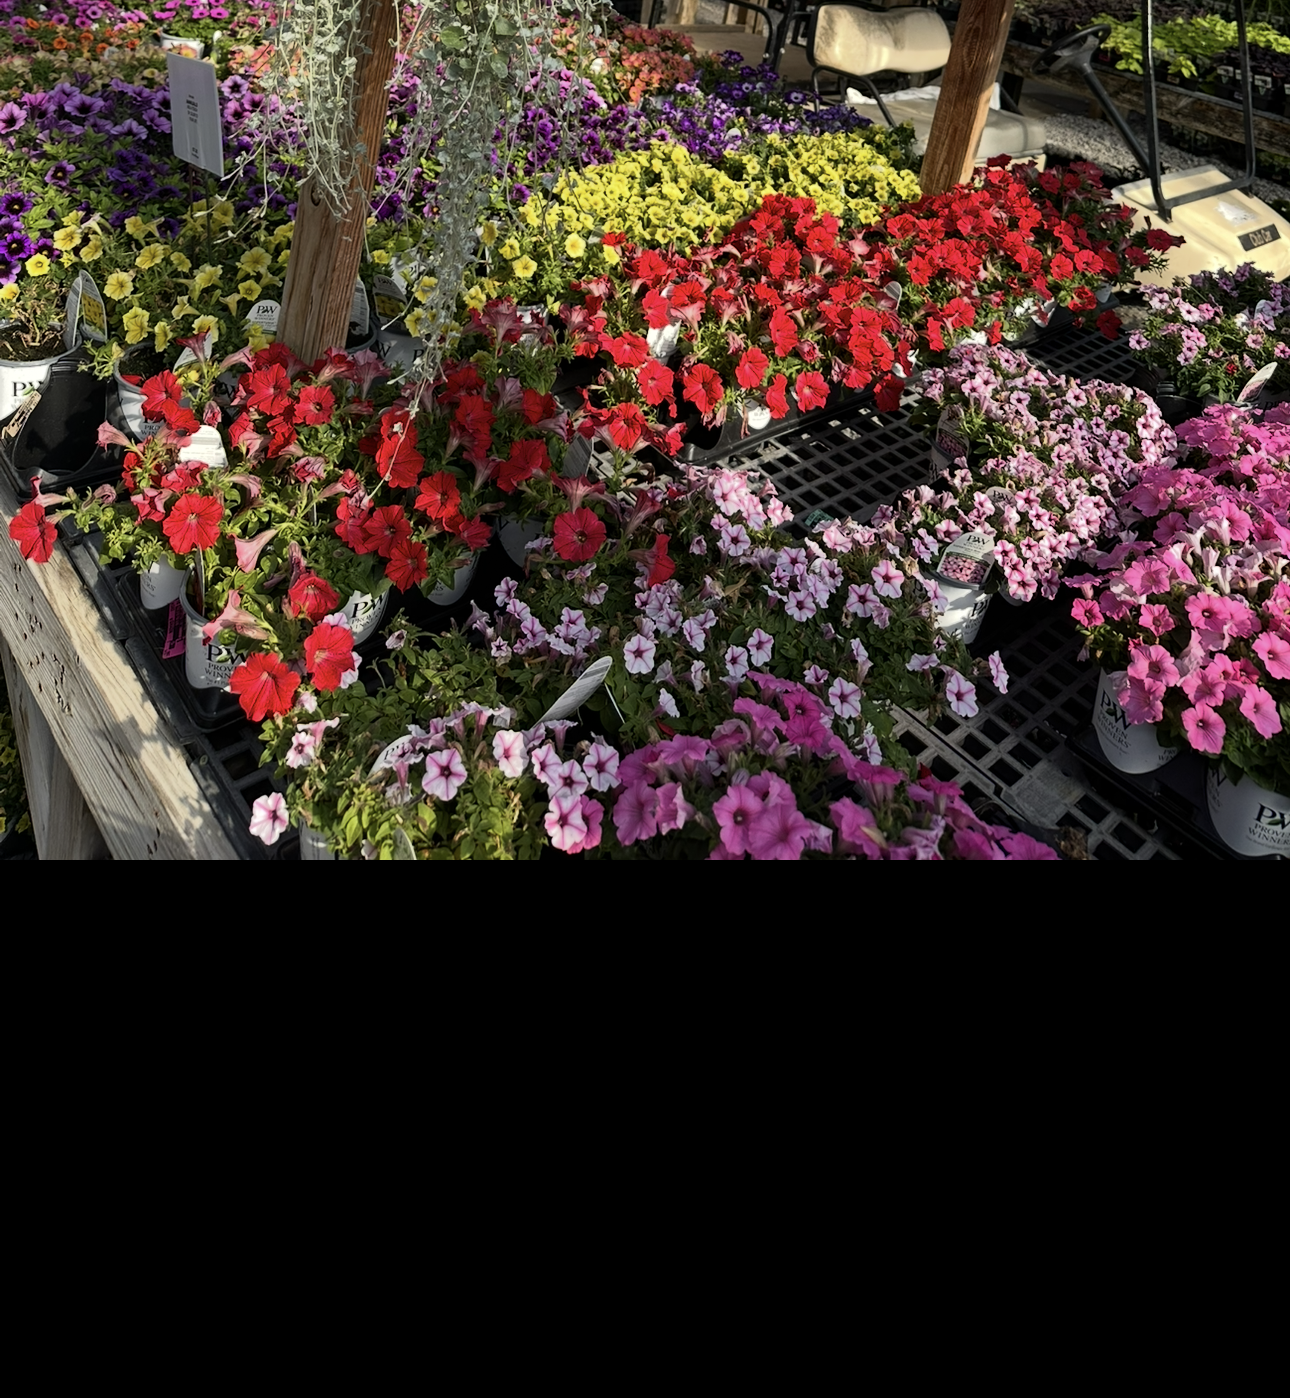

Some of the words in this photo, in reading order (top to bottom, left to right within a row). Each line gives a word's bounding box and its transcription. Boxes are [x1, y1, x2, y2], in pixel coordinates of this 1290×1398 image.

[1249, 231, 1265, 247] Club
[1260, 228, 1273, 243] Car
[256, 305, 278, 314] PW
[965, 534, 991, 546] PW
[204, 667, 231, 679] WINN
[208, 663, 236, 672] PROV
[1100, 689, 1132, 730] PW
